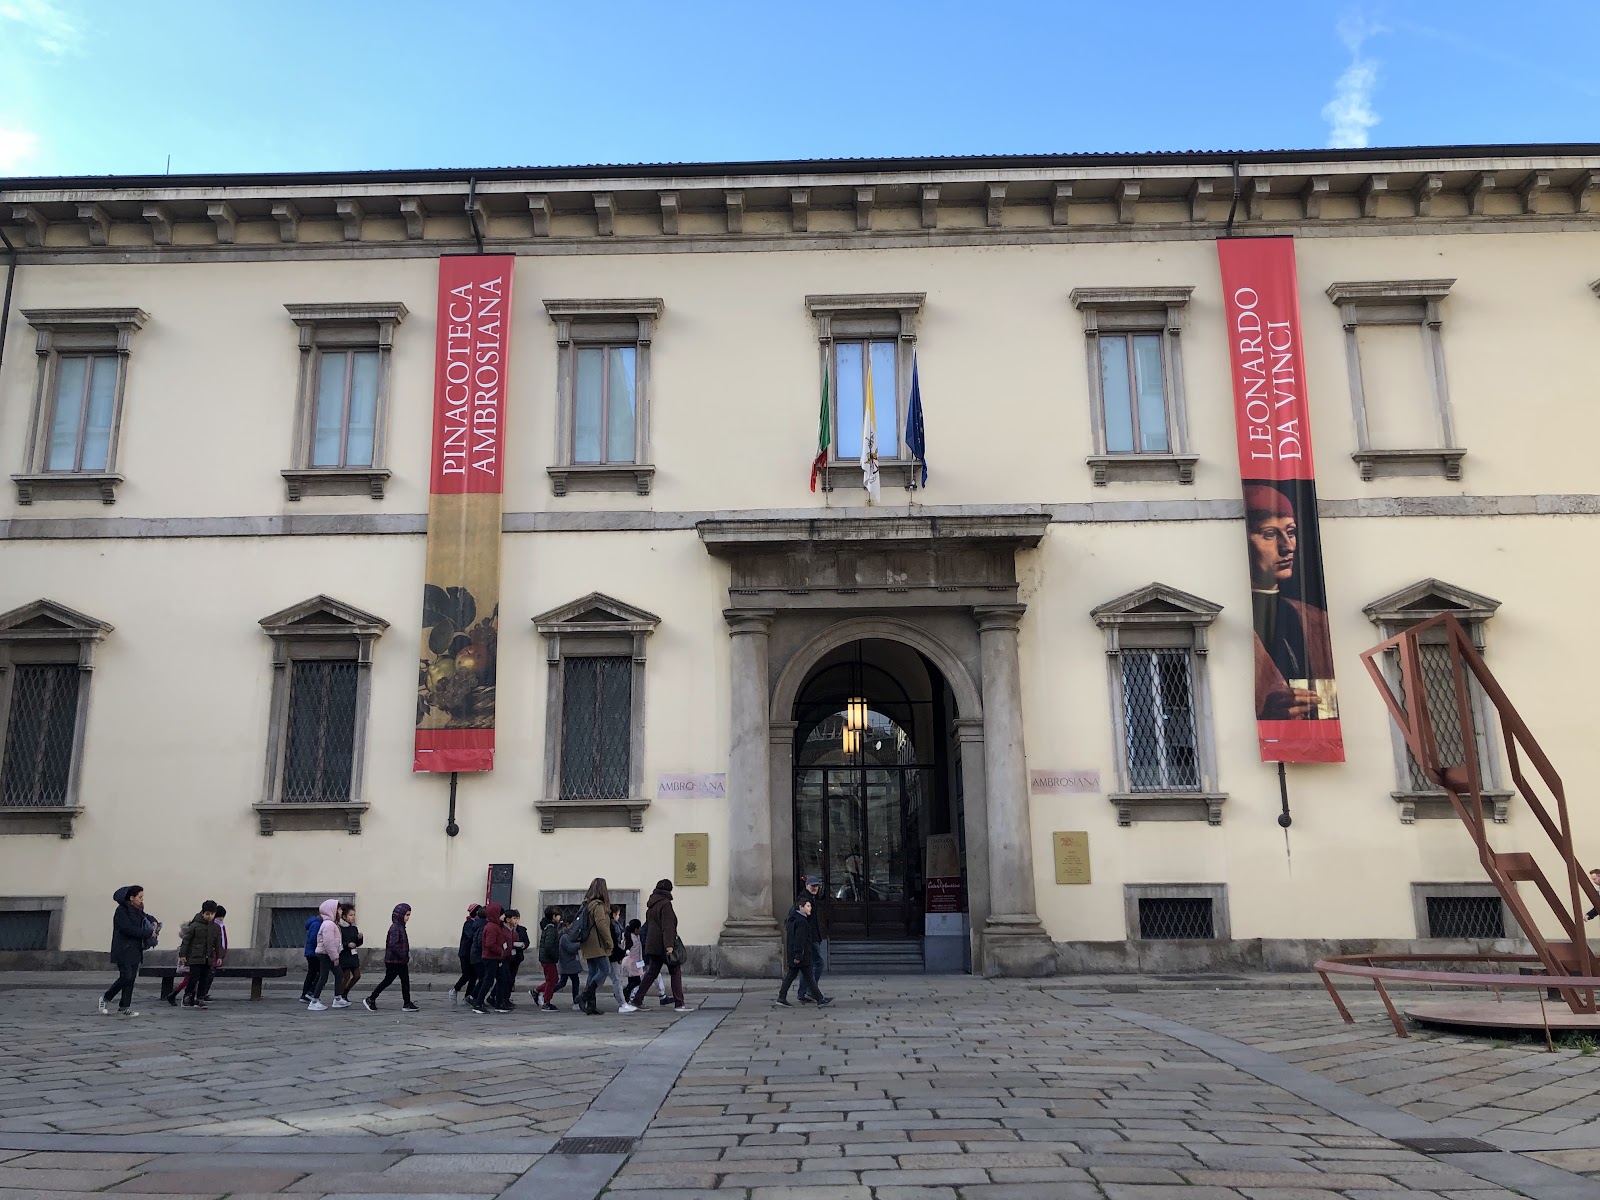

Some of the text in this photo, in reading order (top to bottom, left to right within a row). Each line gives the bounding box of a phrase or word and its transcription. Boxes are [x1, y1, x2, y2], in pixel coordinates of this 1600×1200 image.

[442, 281, 473, 476] PINACOTECA
[471, 276, 502, 477] AMBROSIANA
[1234, 287, 1273, 461] LEONARDO
[1266, 320, 1302, 461] DA VINCI
[658, 781, 725, 792] AMBROANA
[1032, 777, 1100, 787] AMBROSIANA
